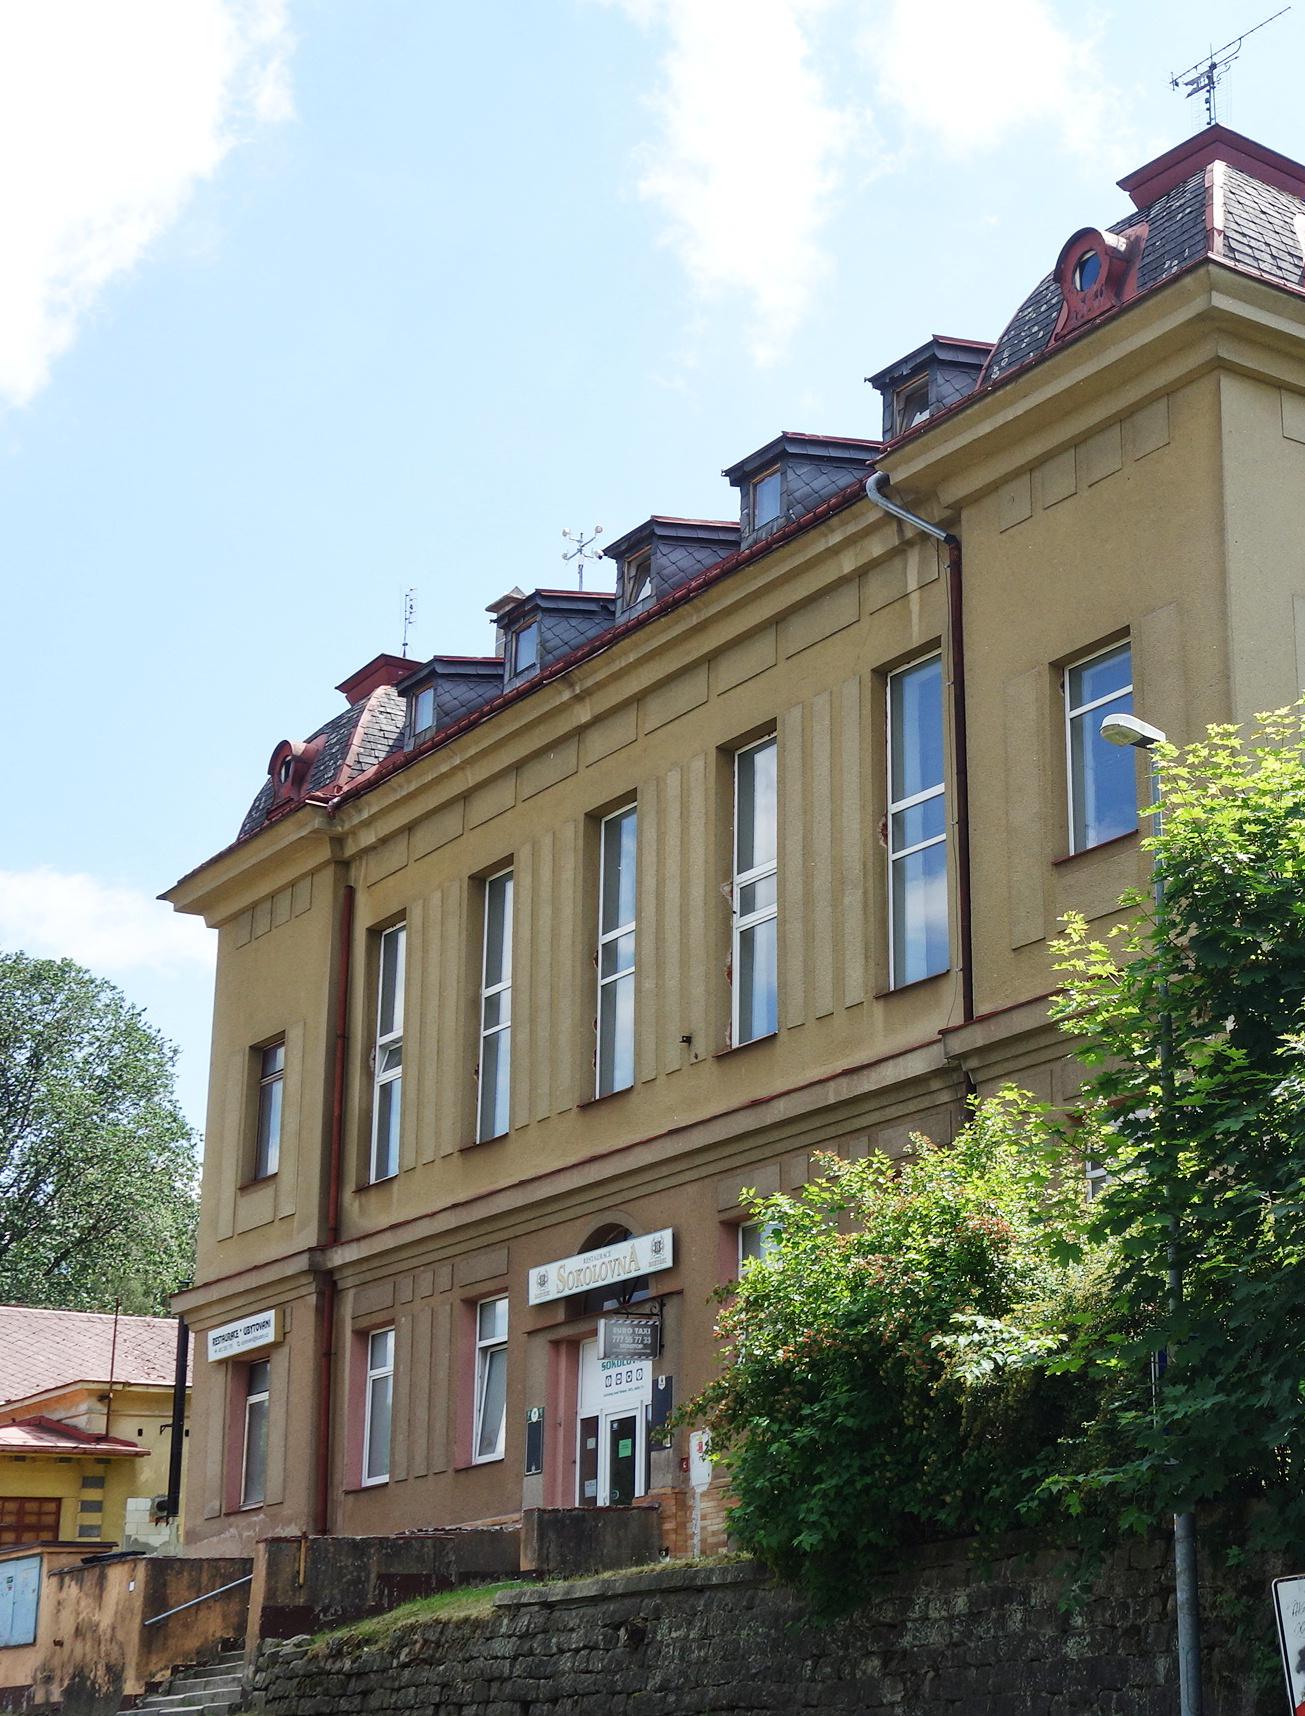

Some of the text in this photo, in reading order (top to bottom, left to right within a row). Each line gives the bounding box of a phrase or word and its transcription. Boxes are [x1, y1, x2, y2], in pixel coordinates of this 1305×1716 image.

[634, 1327, 651, 1335] TAXI
[612, 1335, 624, 1343] 777
[633, 1335, 643, 1344] 77
